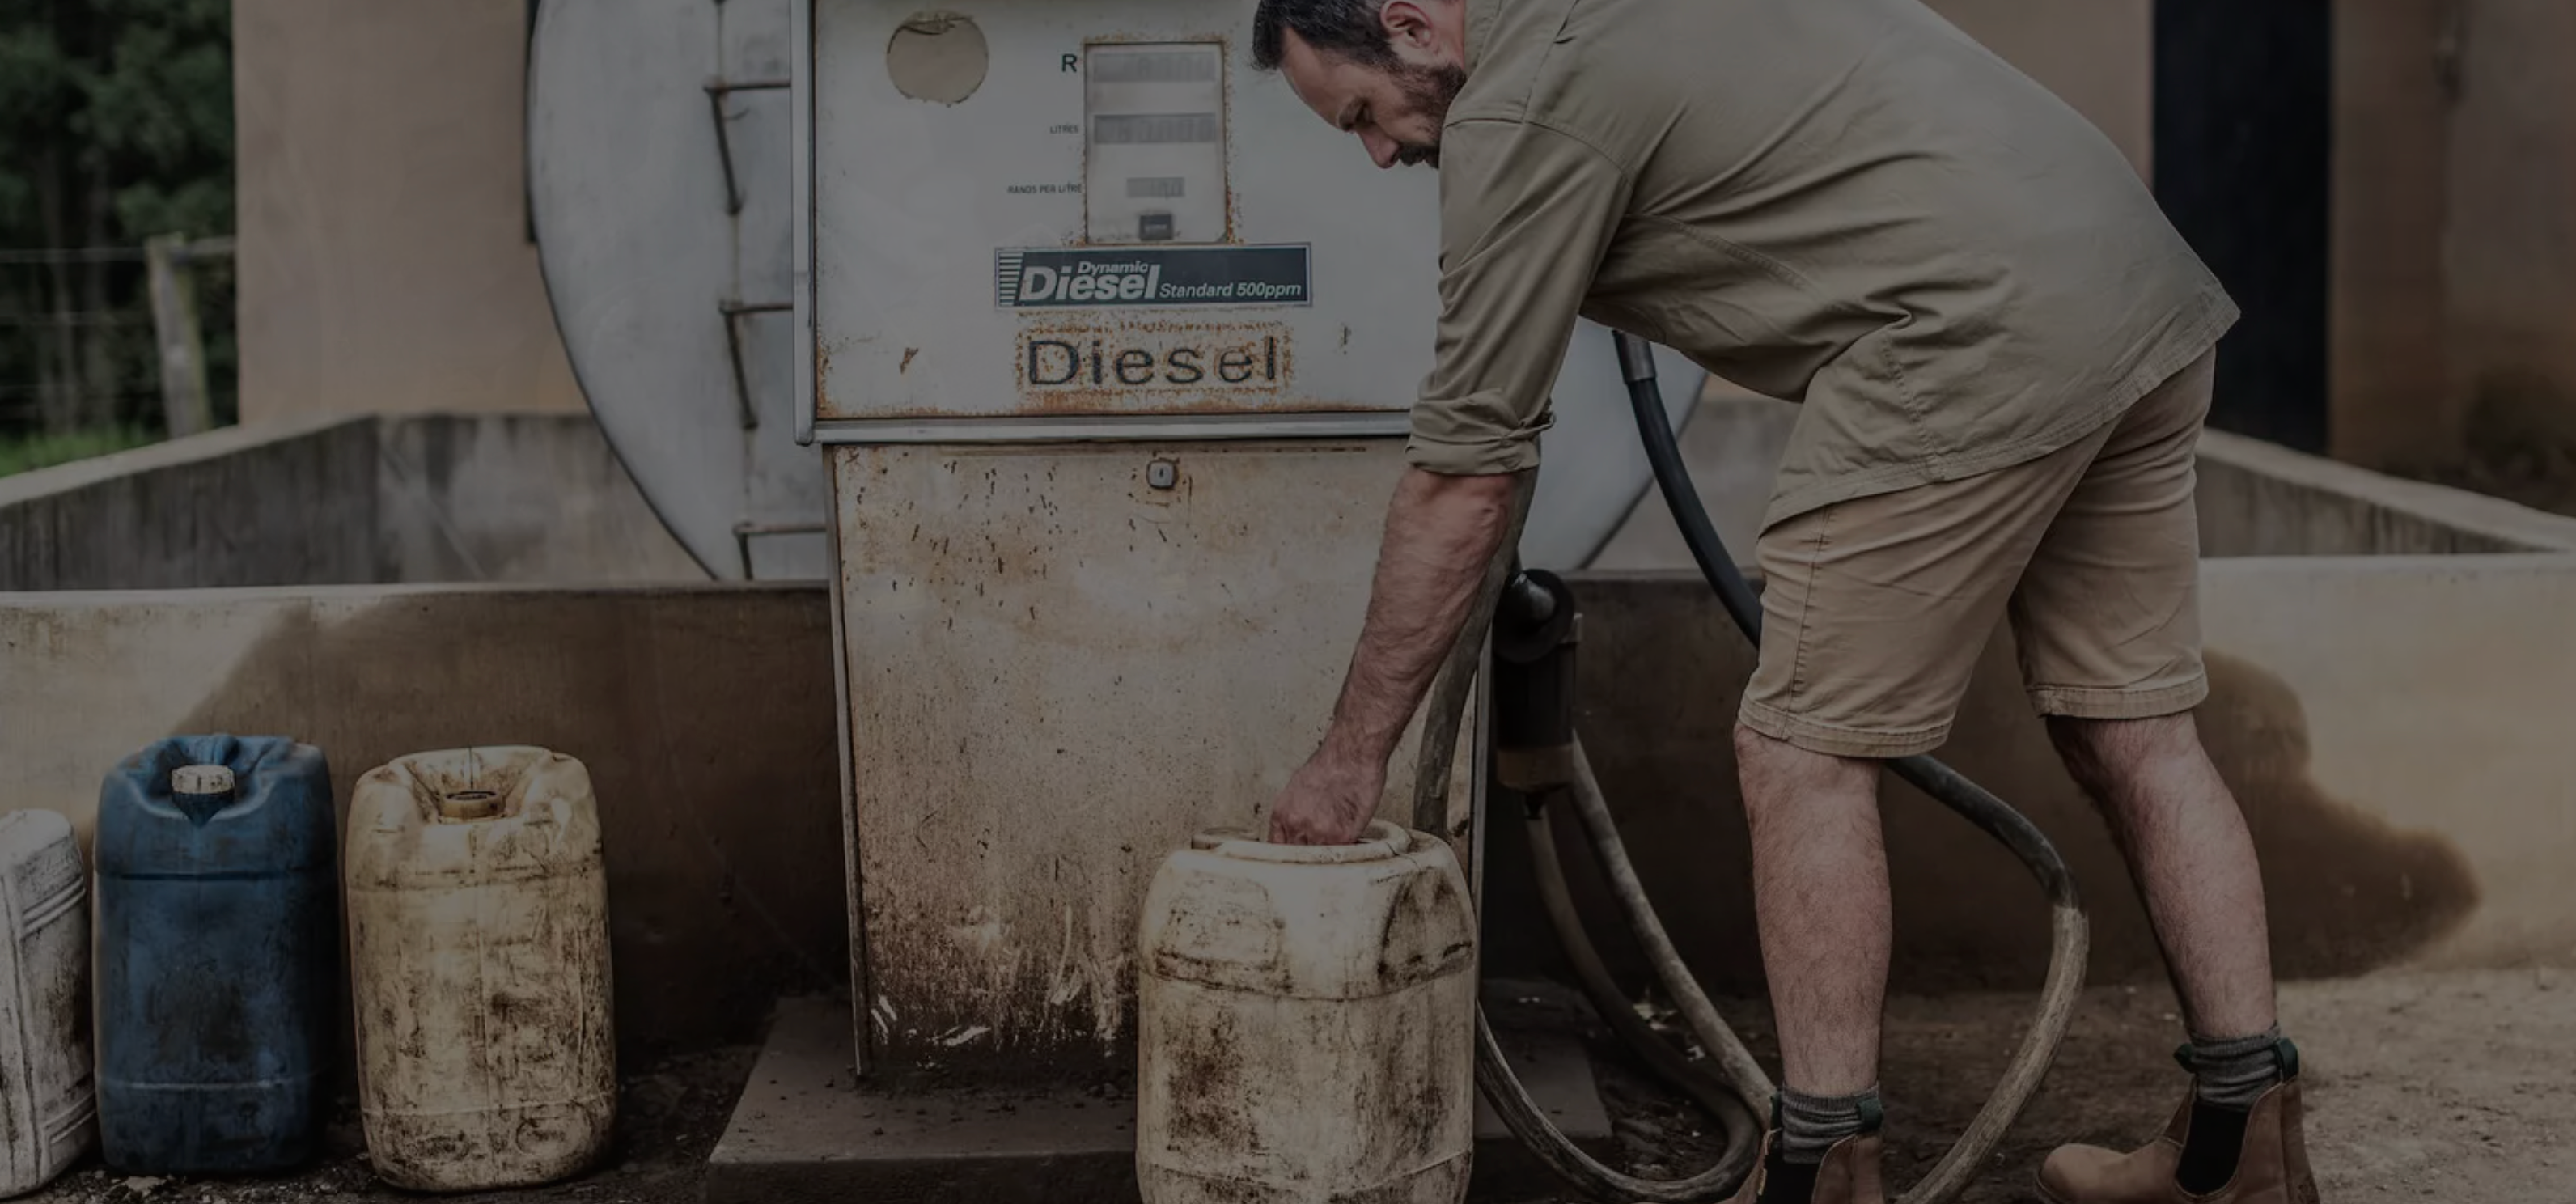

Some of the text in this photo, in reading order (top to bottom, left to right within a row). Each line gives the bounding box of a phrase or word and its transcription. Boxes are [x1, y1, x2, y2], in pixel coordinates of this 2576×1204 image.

[1061, 53, 1078, 73] R
[1049, 125, 1079, 134] LITRES
[1039, 184, 1057, 193] PER
[1058, 182, 1083, 193] LITRE
[1078, 260, 1149, 275] Dynamic
[1018, 263, 1303, 302] Diesel Standard 500ppm
[1028, 337, 1275, 386] Diesel
